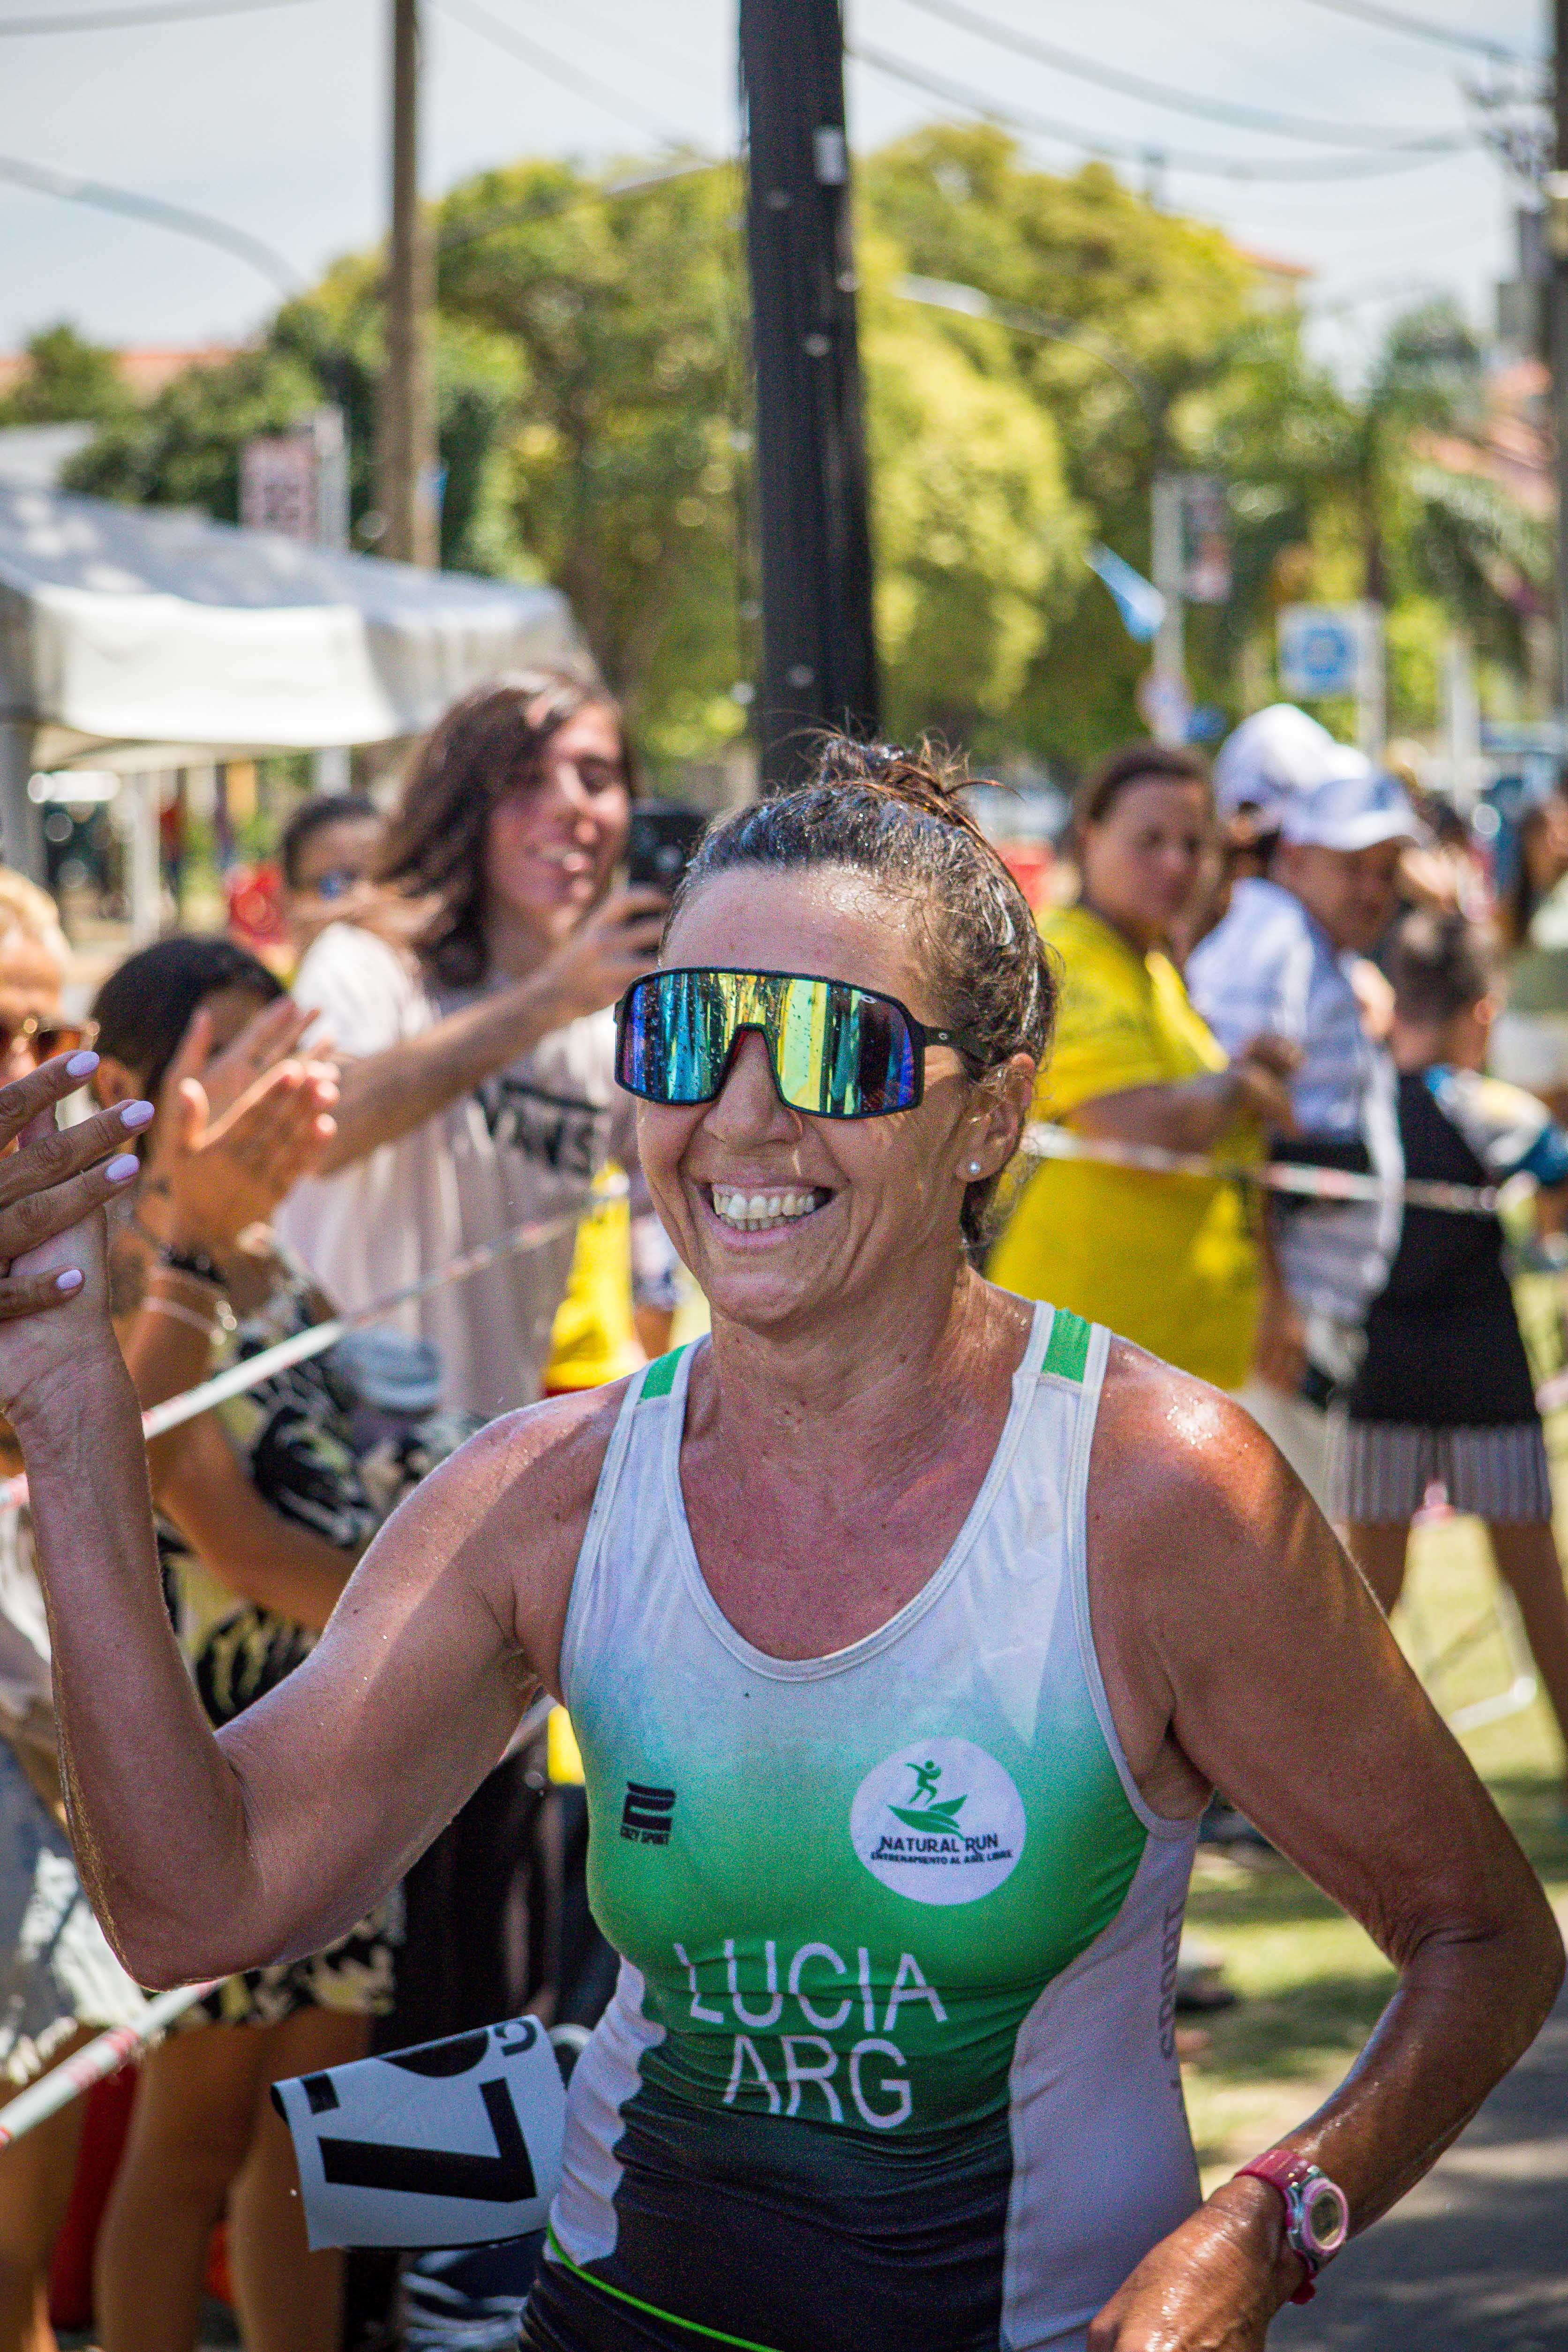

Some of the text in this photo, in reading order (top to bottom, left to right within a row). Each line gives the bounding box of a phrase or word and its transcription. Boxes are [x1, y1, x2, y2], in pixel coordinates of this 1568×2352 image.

[878, 1833, 998, 1853] NATURAL RUN
[673, 1938, 950, 2032] LUCIA
[723, 2033, 912, 2129] ARG
